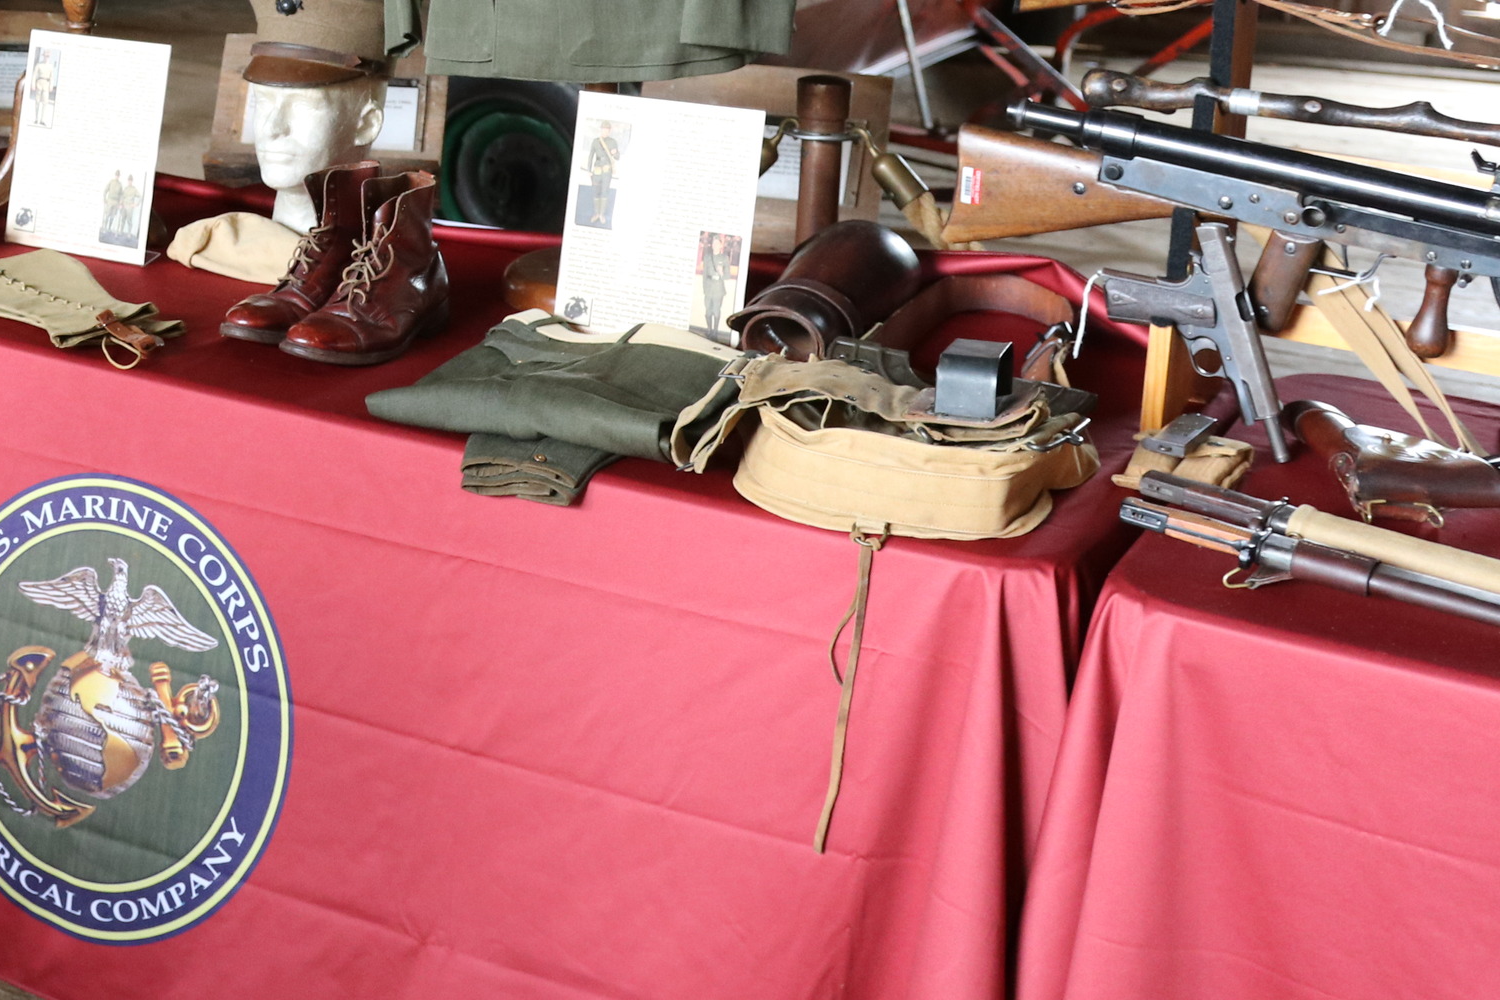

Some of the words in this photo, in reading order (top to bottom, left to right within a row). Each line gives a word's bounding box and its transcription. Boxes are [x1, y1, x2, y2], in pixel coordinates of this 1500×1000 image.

[20, 494, 174, 541] MARINE
[176, 533, 270, 674] CORPS
[90, 815, 247, 924] COMPANY
